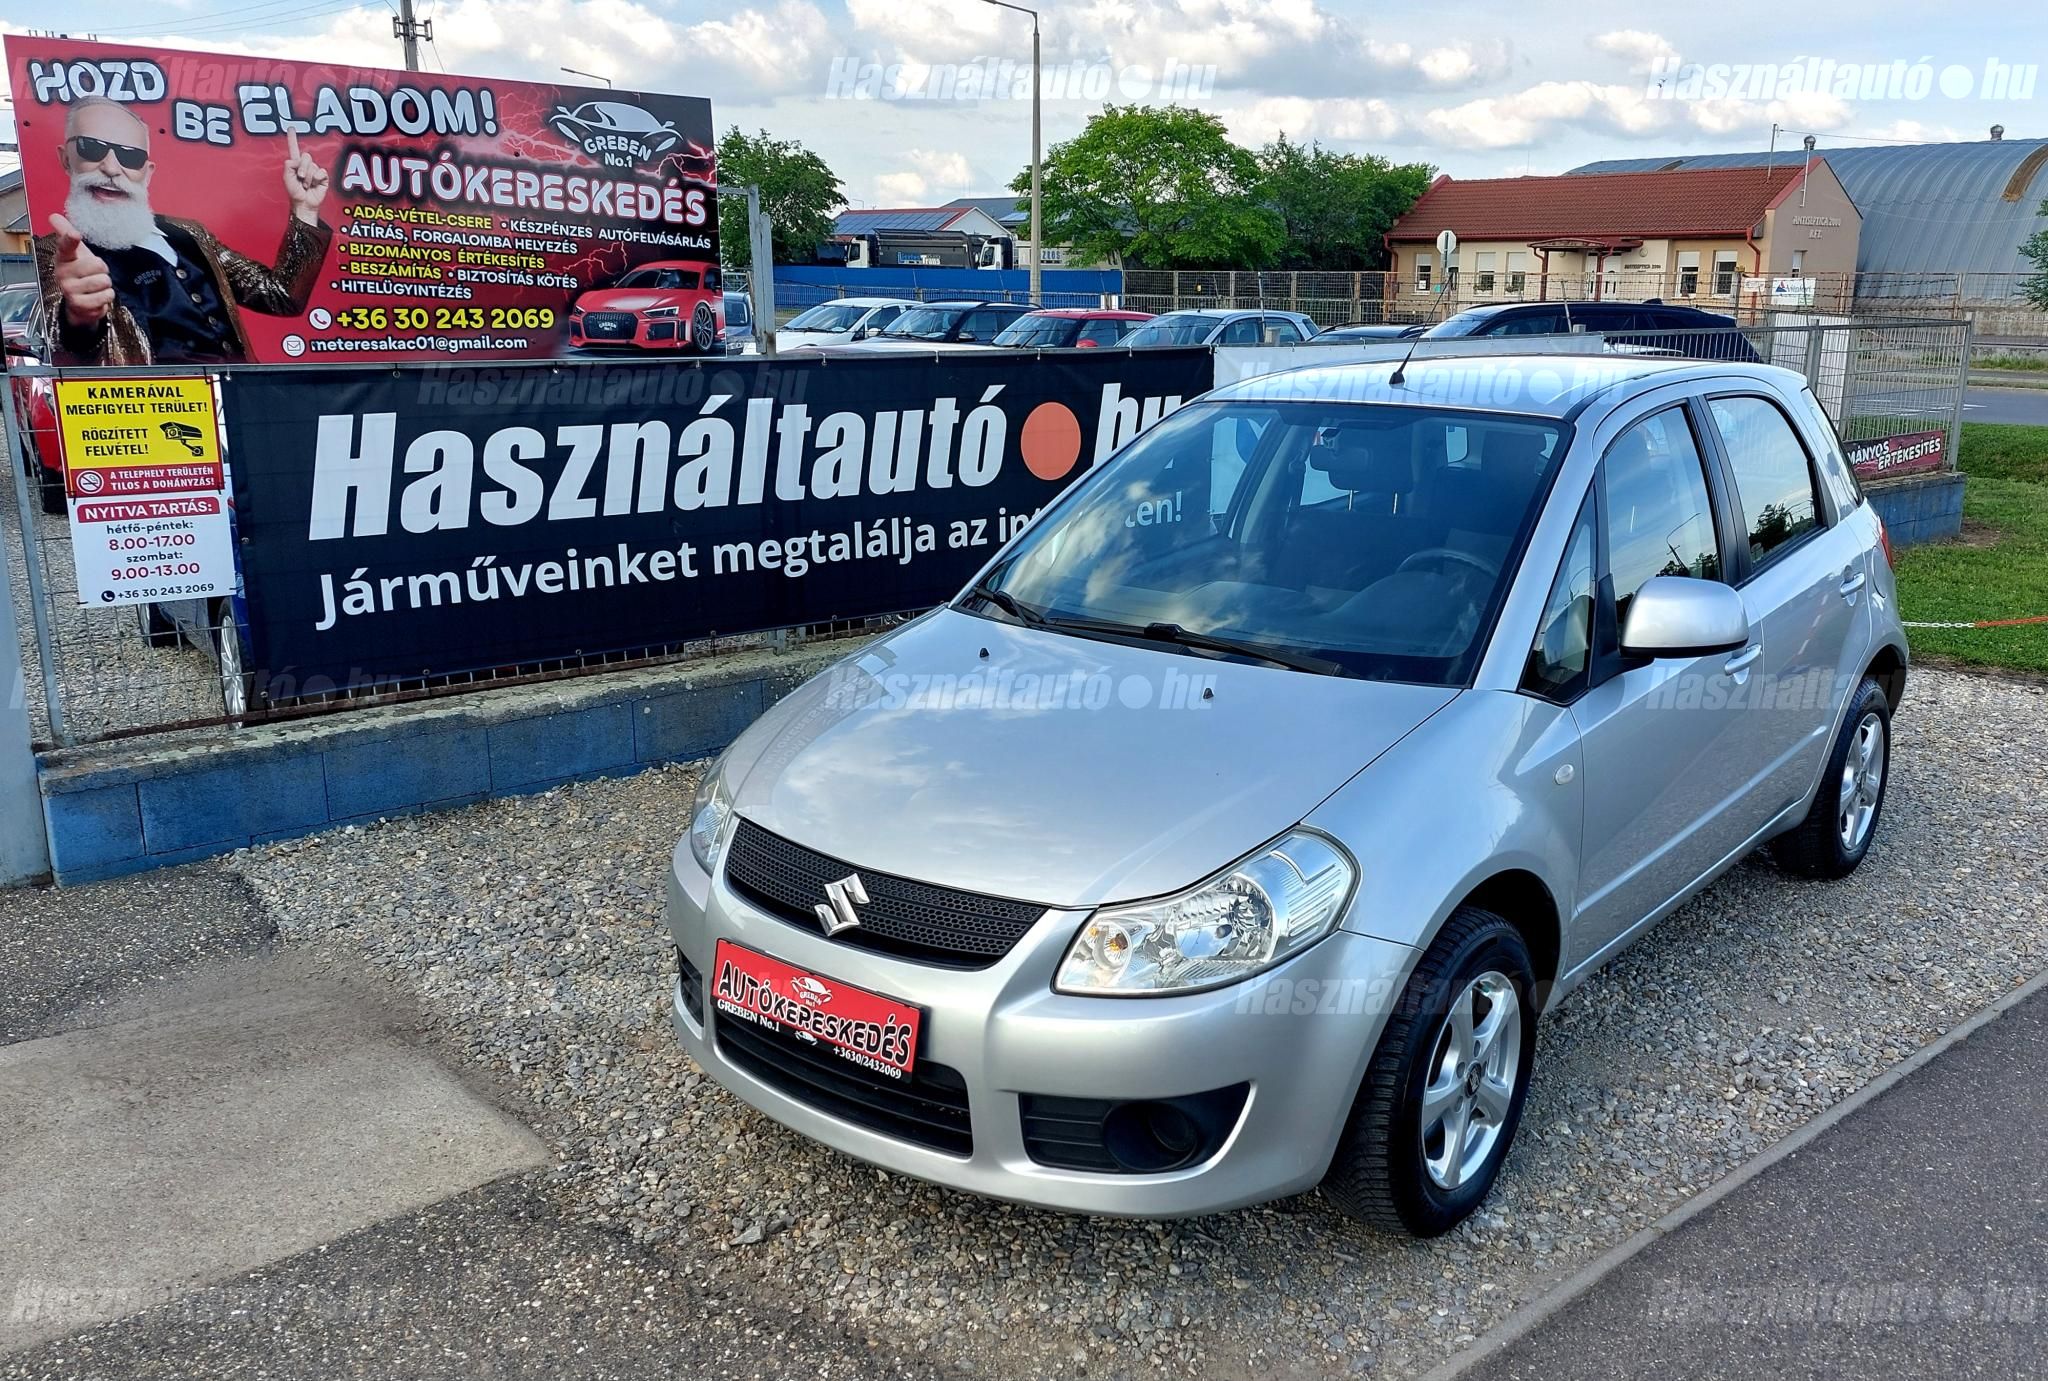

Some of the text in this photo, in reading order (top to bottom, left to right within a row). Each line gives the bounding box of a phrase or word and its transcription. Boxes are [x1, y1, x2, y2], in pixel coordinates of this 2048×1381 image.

[31, 61, 166, 103] HOZD
[175, 86, 498, 144] BE ELADOM!
[584, 135, 652, 161] GREBEN
[605, 153, 633, 167] No.1
[343, 152, 706, 224] AUTÓKERESKEDÉS
[353, 205, 711, 249] ADÁS-VÉTEL-CSERE KÉSZPÉNZES AUTÓFELVÁSÁRLÁS
[350, 222, 577, 254] ÁTÍRÁS, FORGALOMBA HELYEZÉS
[350, 243, 545, 269] BIZOMÁNYOS ÉRTÉKESÍTÉS
[351, 261, 578, 289] BESZÁMÍTÁS BIZTOSÍTÁS KÖTÉS
[342, 279, 472, 299] HITELÜGYINTÉZÉS
[337, 308, 555, 329] +36 30 243 2069
[88, 384, 184, 399] KAMERÁVAL
[66, 401, 208, 415] MEGFIGYELT TERÜLET!
[82, 426, 148, 441] RÖGZÍTETT
[85, 442, 149, 457] FELVÉTEL!
[110, 466, 214, 480] A TELEPHELY TERÜLETÉN
[308, 384, 1007, 541] Használtautó
[111, 477, 215, 491] TILOS A DOHÁNYZÁS!
[85, 499, 213, 520] NYITVA TARTÁS:
[106, 520, 194, 535] hétfő-péntek:
[109, 533, 195, 551] 8.00-17.00
[126, 551, 183, 564] szombat:
[111, 562, 200, 581] 9.00-13.00
[315, 542, 698, 631] Járműveinket
[713, 516, 936, 577] megtalálja
[948, 518, 987, 548] az
[117, 583, 215, 599] +36 30 243 2069
[717, 960, 912, 1067] AUTÓKERESKEDÉS
[717, 999, 780, 1033] GREBEN No.1
[833, 1046, 902, 1079] +3630/2432069
